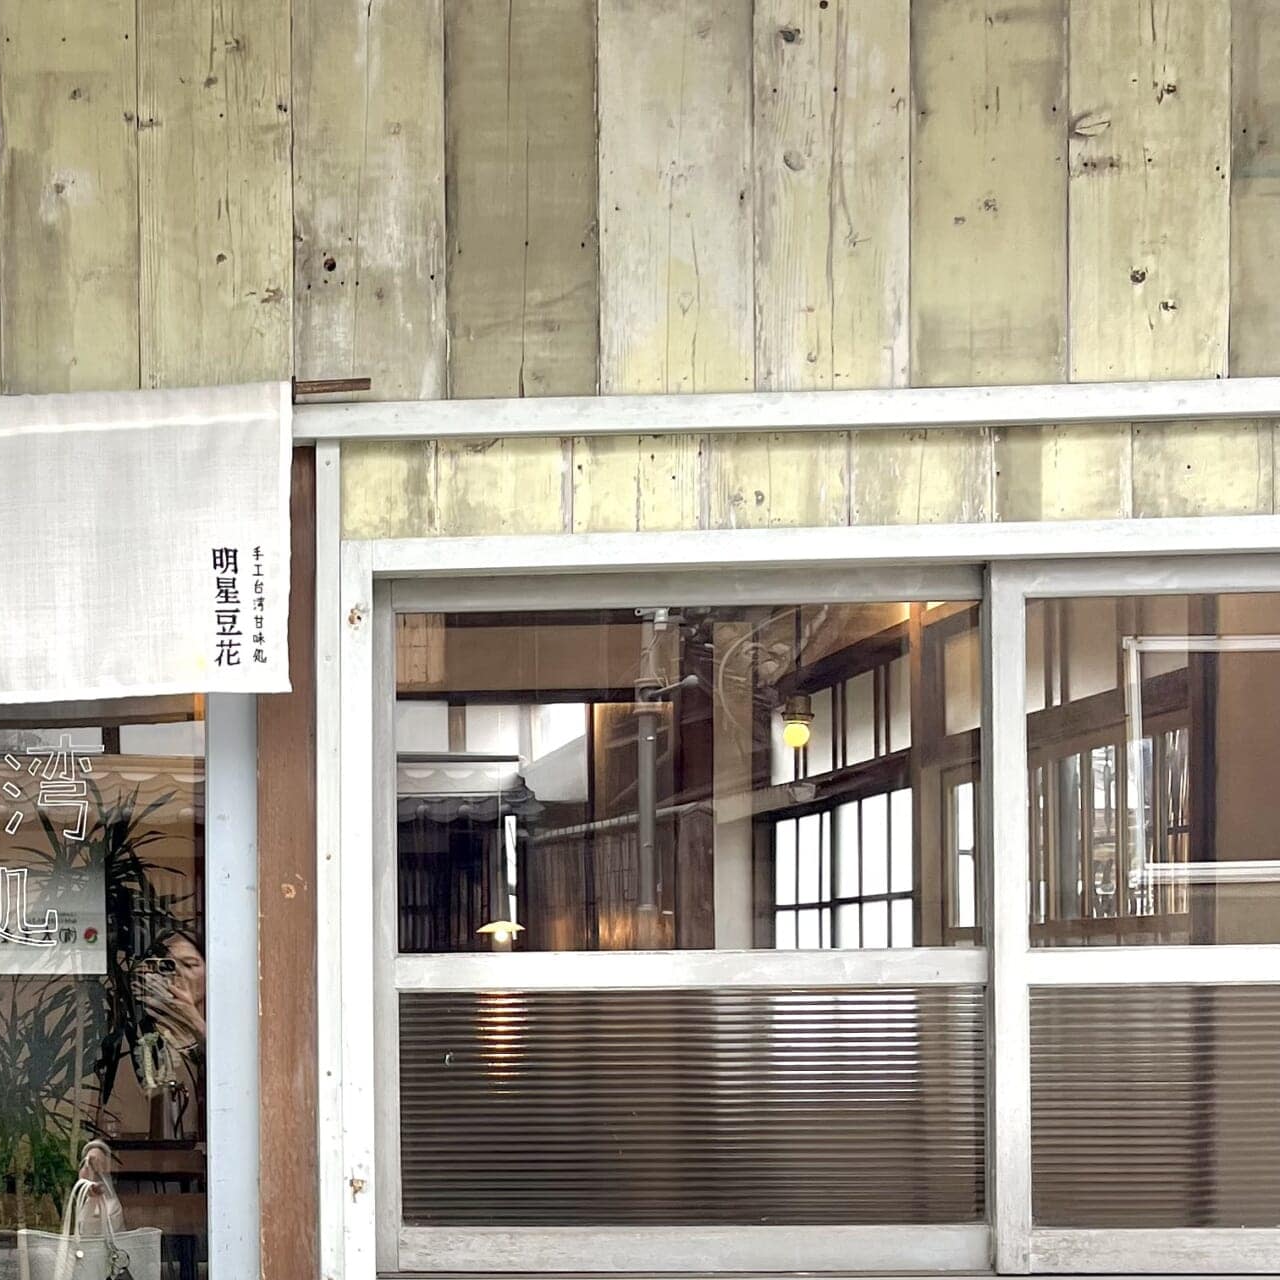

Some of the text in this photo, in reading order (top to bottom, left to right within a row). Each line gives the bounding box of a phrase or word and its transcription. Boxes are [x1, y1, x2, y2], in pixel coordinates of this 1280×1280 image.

[212, 547, 242, 667] 明星豆花
[252, 546, 268, 664] 手工台湾甘味処
